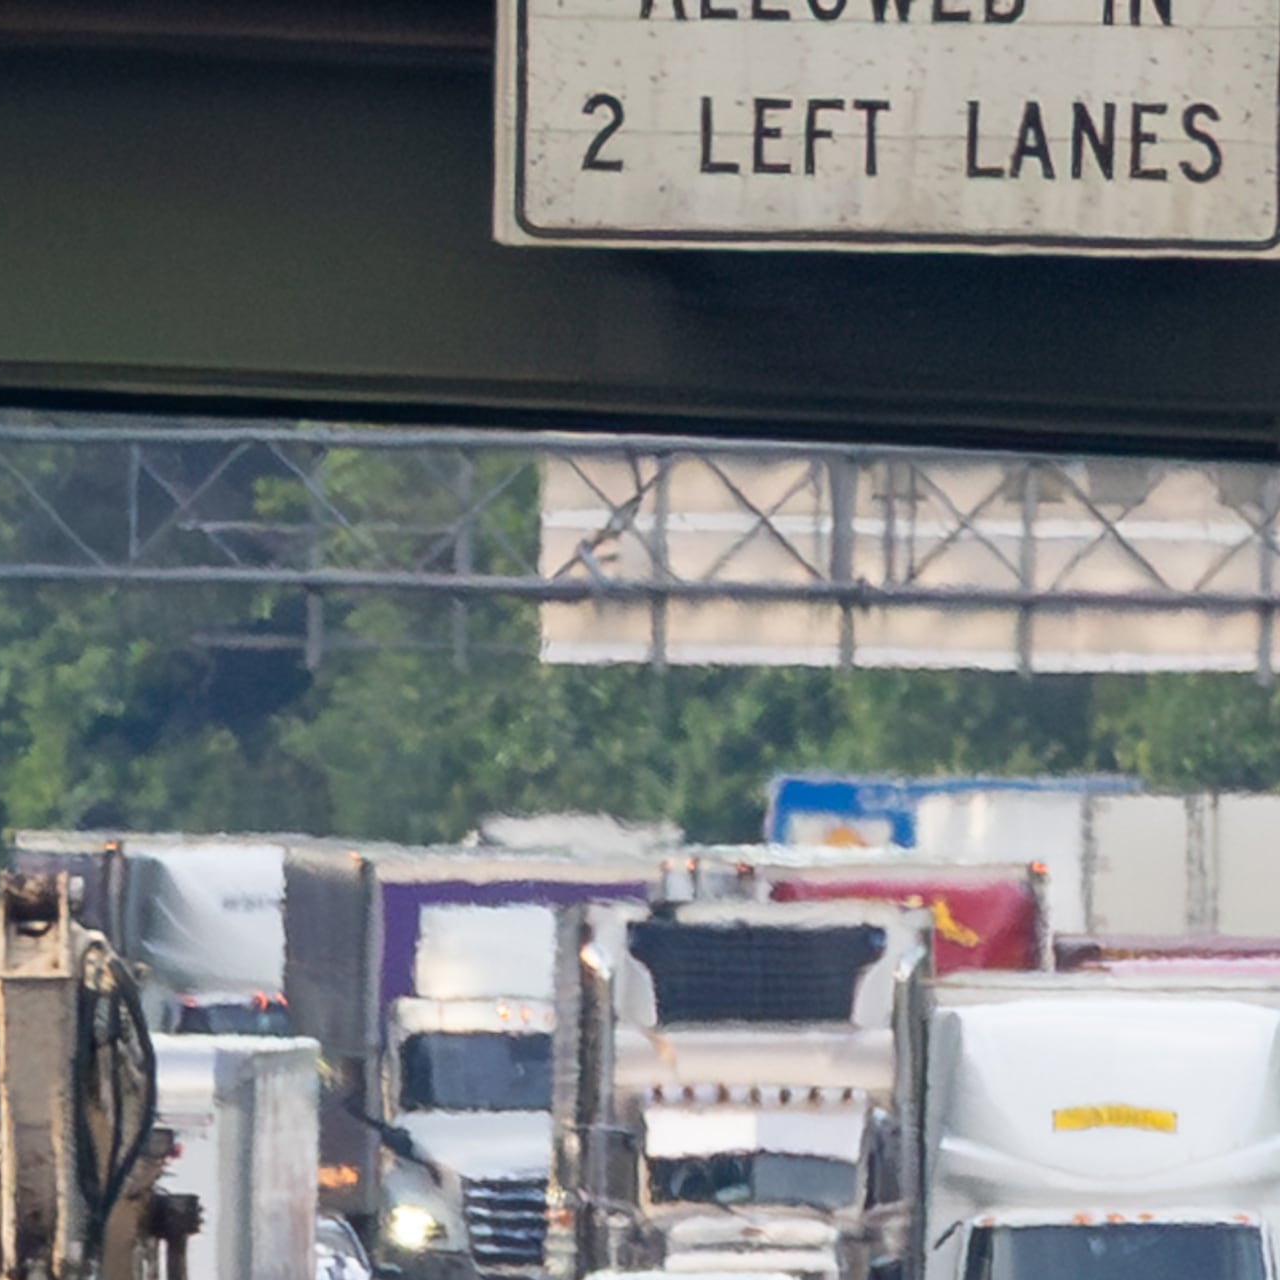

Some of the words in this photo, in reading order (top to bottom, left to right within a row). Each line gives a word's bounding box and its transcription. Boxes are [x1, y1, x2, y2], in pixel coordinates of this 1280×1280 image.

[581, 93, 625, 172] 2
[699, 97, 891, 176] LEFT
[966, 100, 1224, 183] LANES
